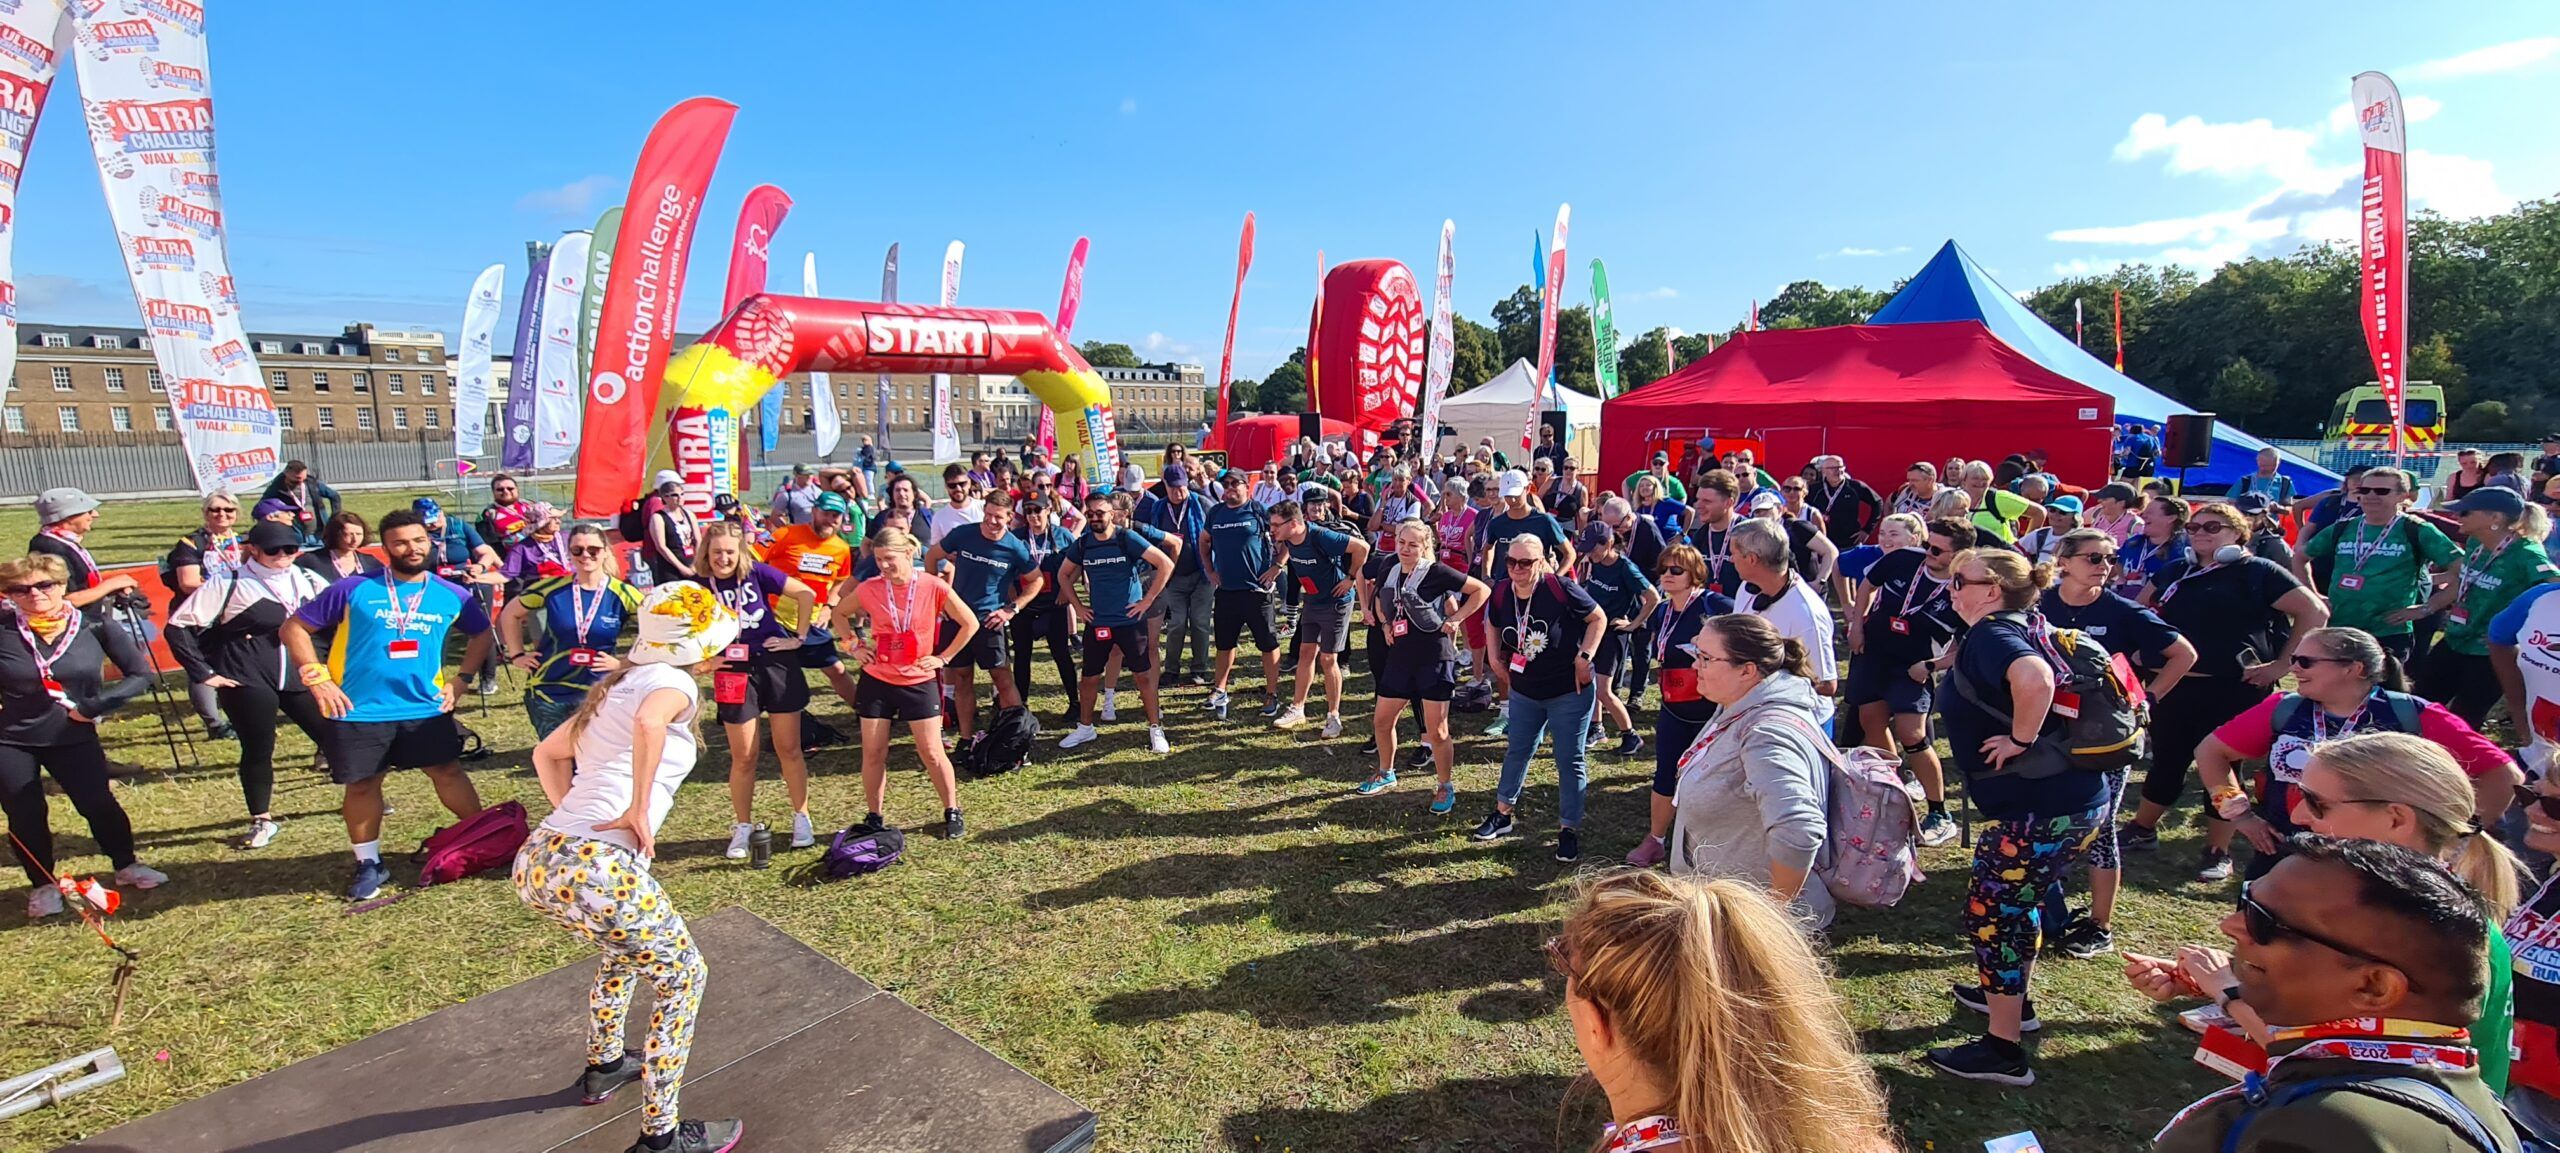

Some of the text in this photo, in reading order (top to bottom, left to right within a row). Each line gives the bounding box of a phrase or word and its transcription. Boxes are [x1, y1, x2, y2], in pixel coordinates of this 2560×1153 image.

[100, 22, 151, 38] ULTRA
[161, 62, 200, 80] ULTRA
[116, 105, 210, 132] ULTRA
[167, 196, 216, 227] ULTRA
[141, 239, 191, 256] ULTRA
[661, 196, 697, 341] challenge events worldwide
[625, 183, 682, 382] actionchallenge
[153, 302, 208, 325] ULTRA
[868, 317, 987, 355] START
[192, 383, 266, 411] ULTRA
[194, 404, 271, 424] CHALLENGE
[1089, 413, 1111, 483] CHALLENGE
[223, 451, 271, 469] ULTRA
[677, 414, 713, 513] ULTRA
[1211, 521, 1251, 530] CUPRA
[961, 550, 1009, 570] CUPRA
[2350, 1047, 2390, 1060] 2023
